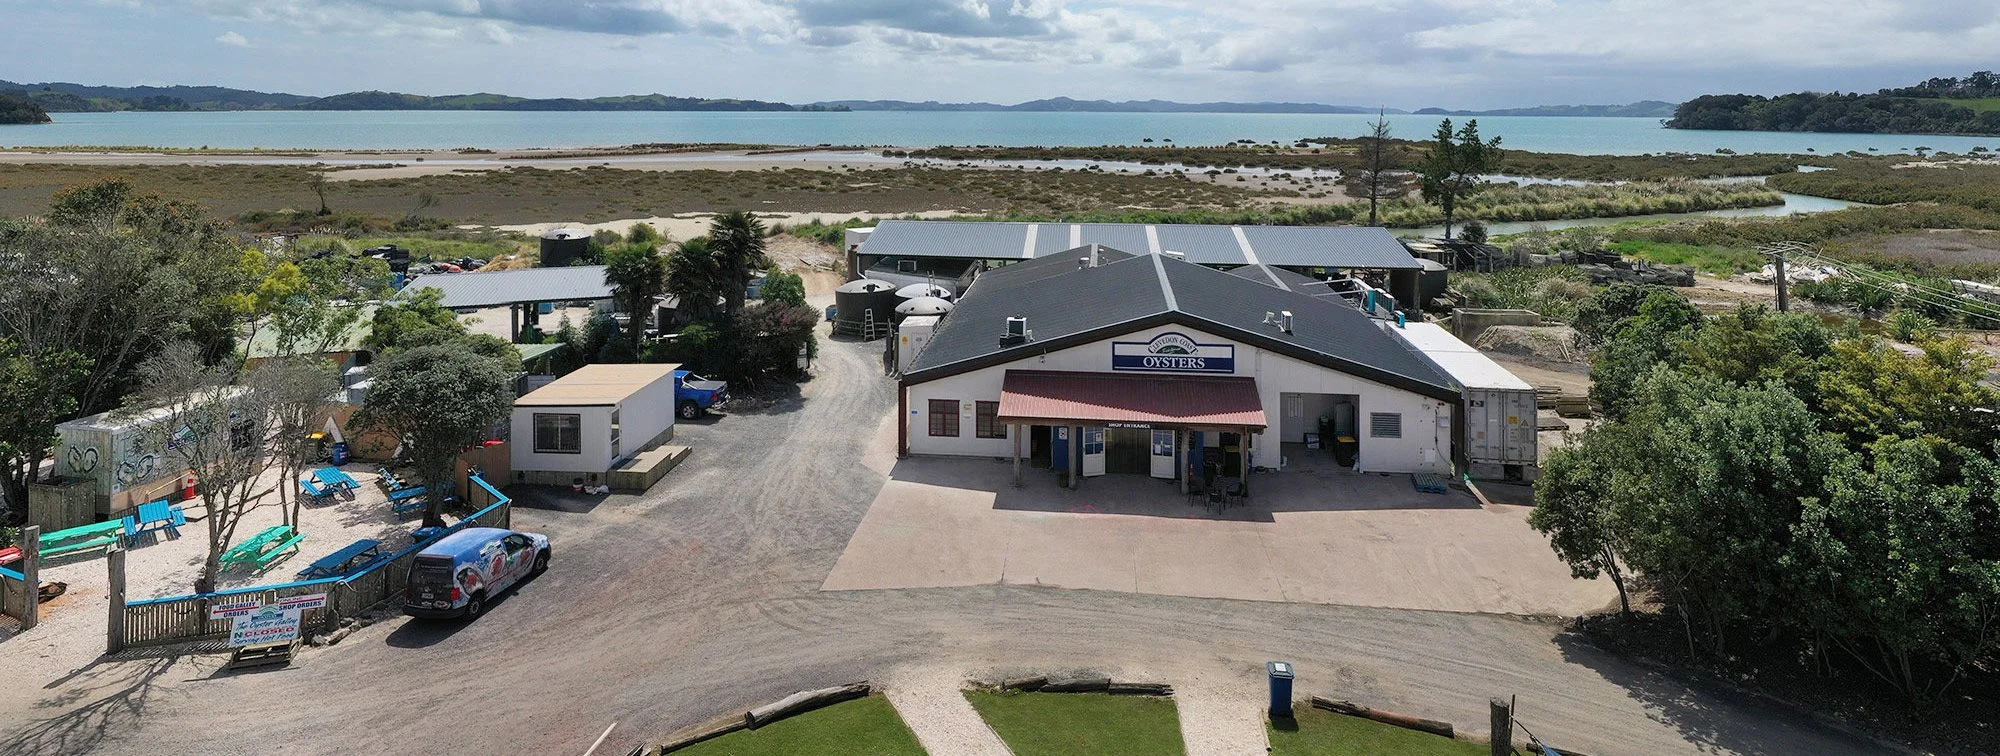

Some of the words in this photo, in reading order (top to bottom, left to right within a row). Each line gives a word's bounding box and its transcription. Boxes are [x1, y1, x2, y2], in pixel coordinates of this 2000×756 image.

[1147, 336, 1178, 354] CLEVEDON
[1180, 336, 1199, 355] COAST
[1143, 356, 1205, 369] OYSTERS
[297, 601, 322, 609] ORDERS
[223, 610, 249, 618] ORDERS
[236, 621, 248, 631] The
[249, 620, 274, 631] Oyster
[275, 617, 298, 627] Galley
[244, 627, 295, 638] CLOSED
[233, 637, 259, 645] Serving
[260, 634, 276, 643] Hot
